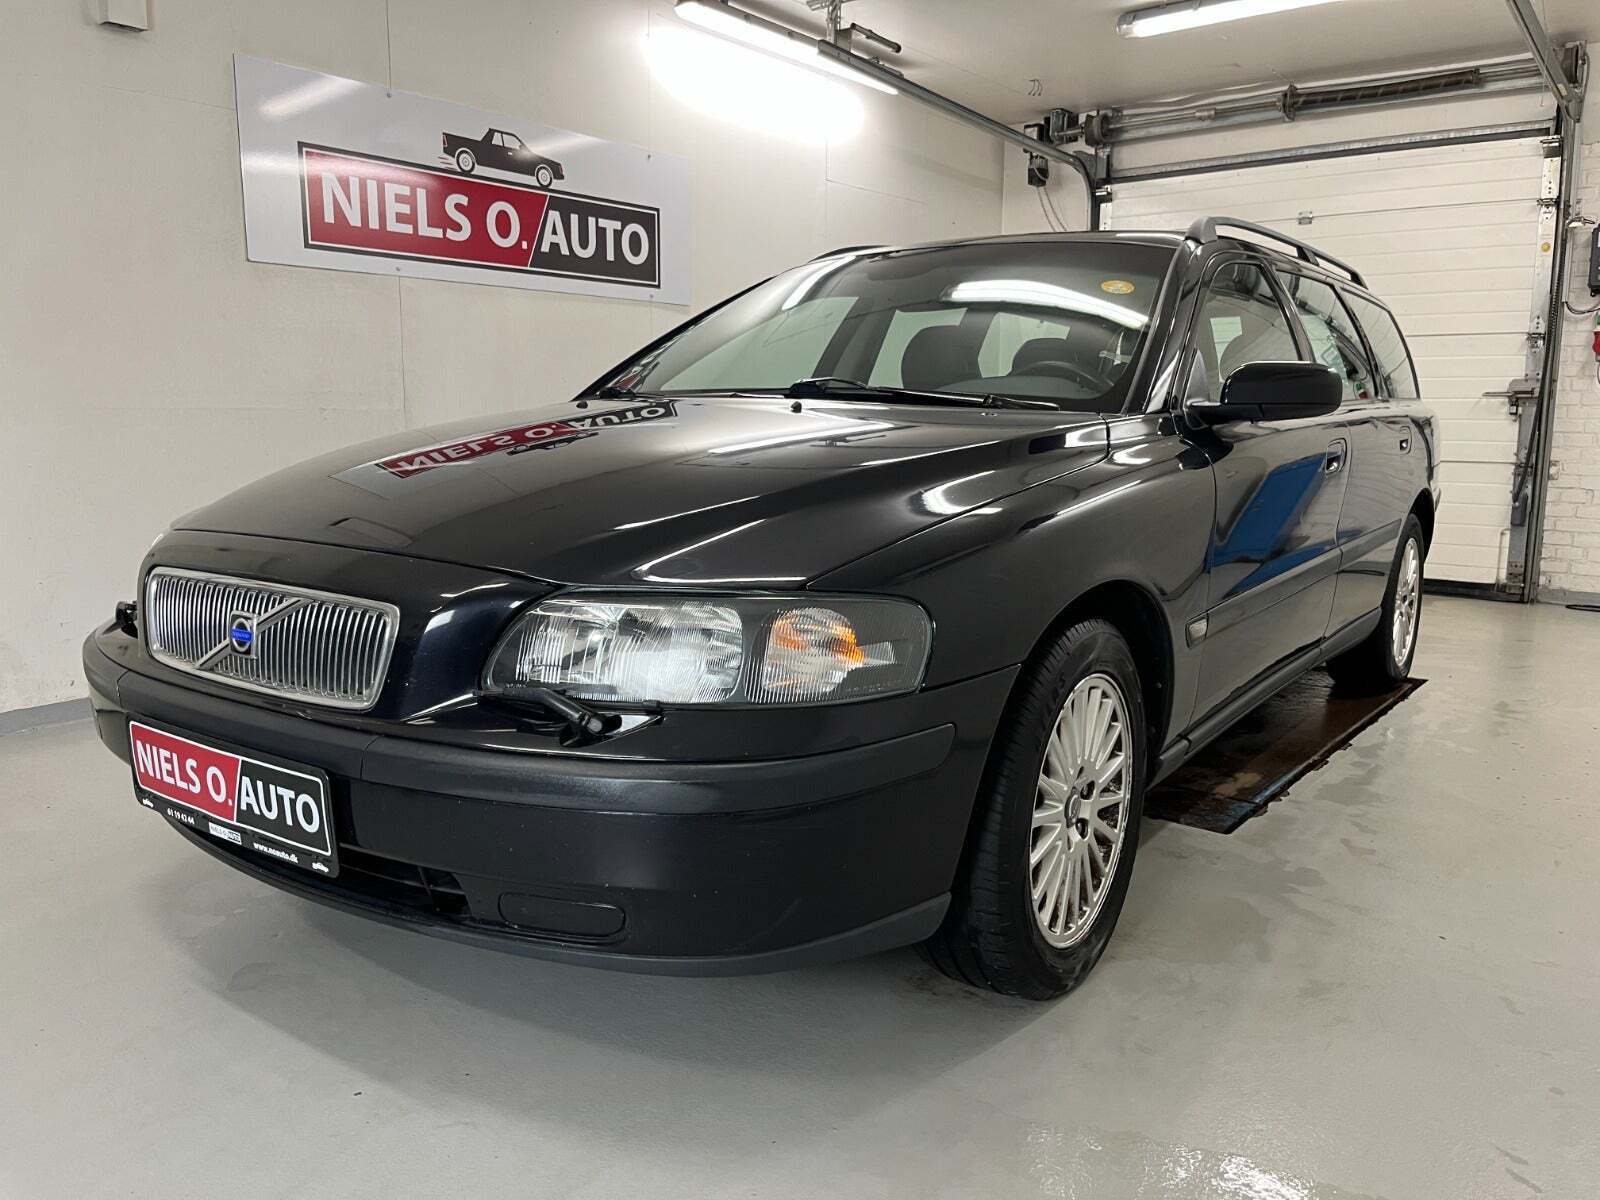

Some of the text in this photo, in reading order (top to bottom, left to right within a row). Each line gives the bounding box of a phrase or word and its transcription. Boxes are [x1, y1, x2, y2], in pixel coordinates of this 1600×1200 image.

[321, 171, 649, 265] NIELS O. AUTO
[135, 740, 320, 833] NIELS O. AUTO
